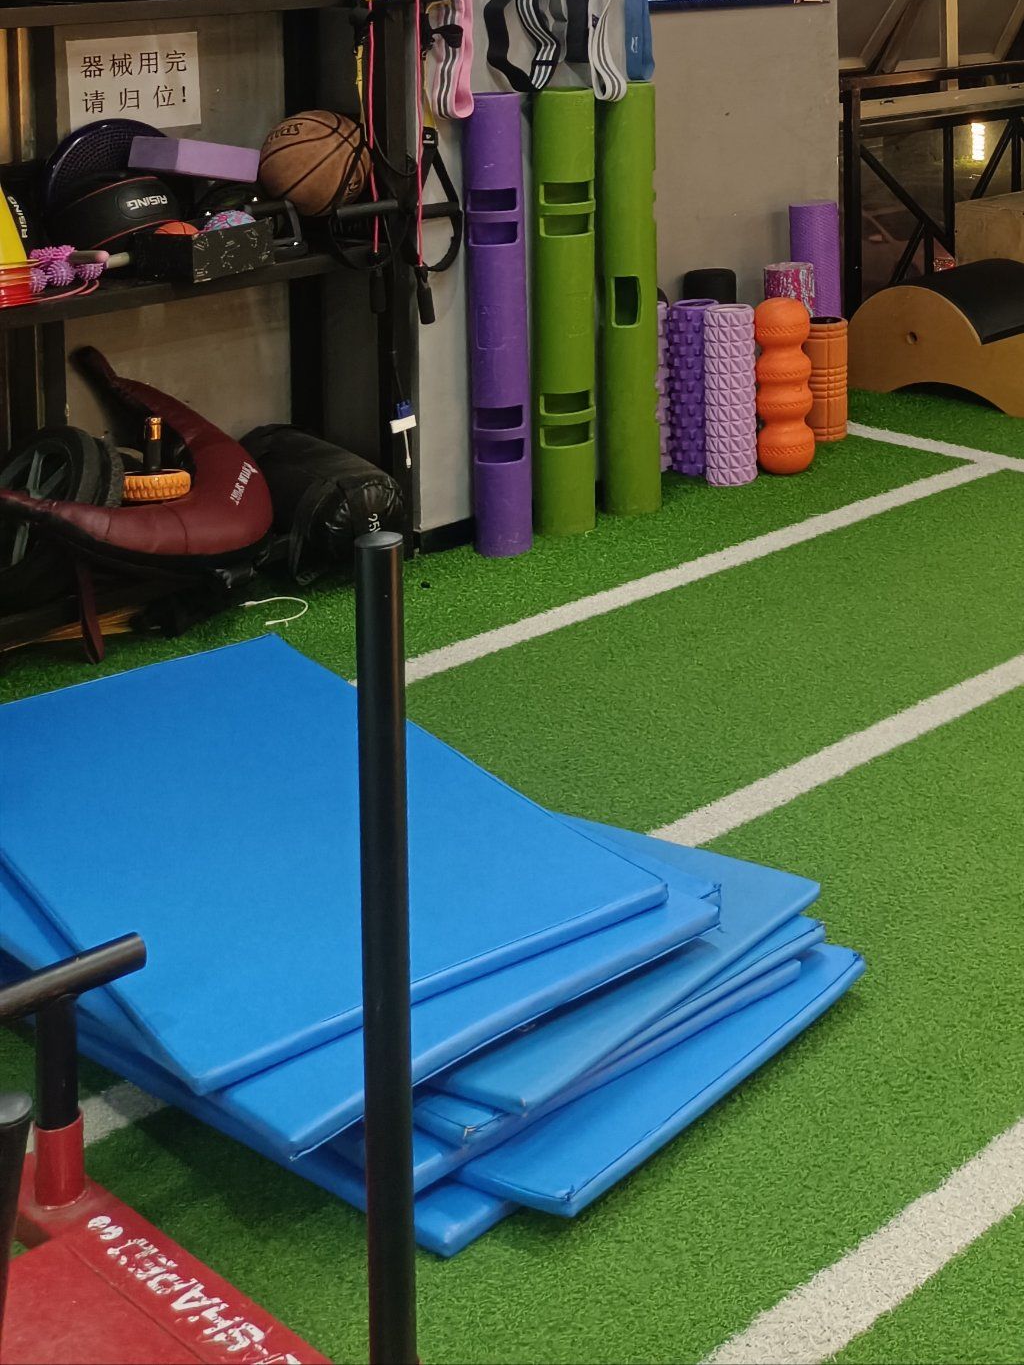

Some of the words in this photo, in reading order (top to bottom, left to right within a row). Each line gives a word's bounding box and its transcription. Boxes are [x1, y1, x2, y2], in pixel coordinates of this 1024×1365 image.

[80, 50, 187, 78] 器械用完
[126, 194, 168, 211] RISING
[7, 195, 28, 239] RISING
